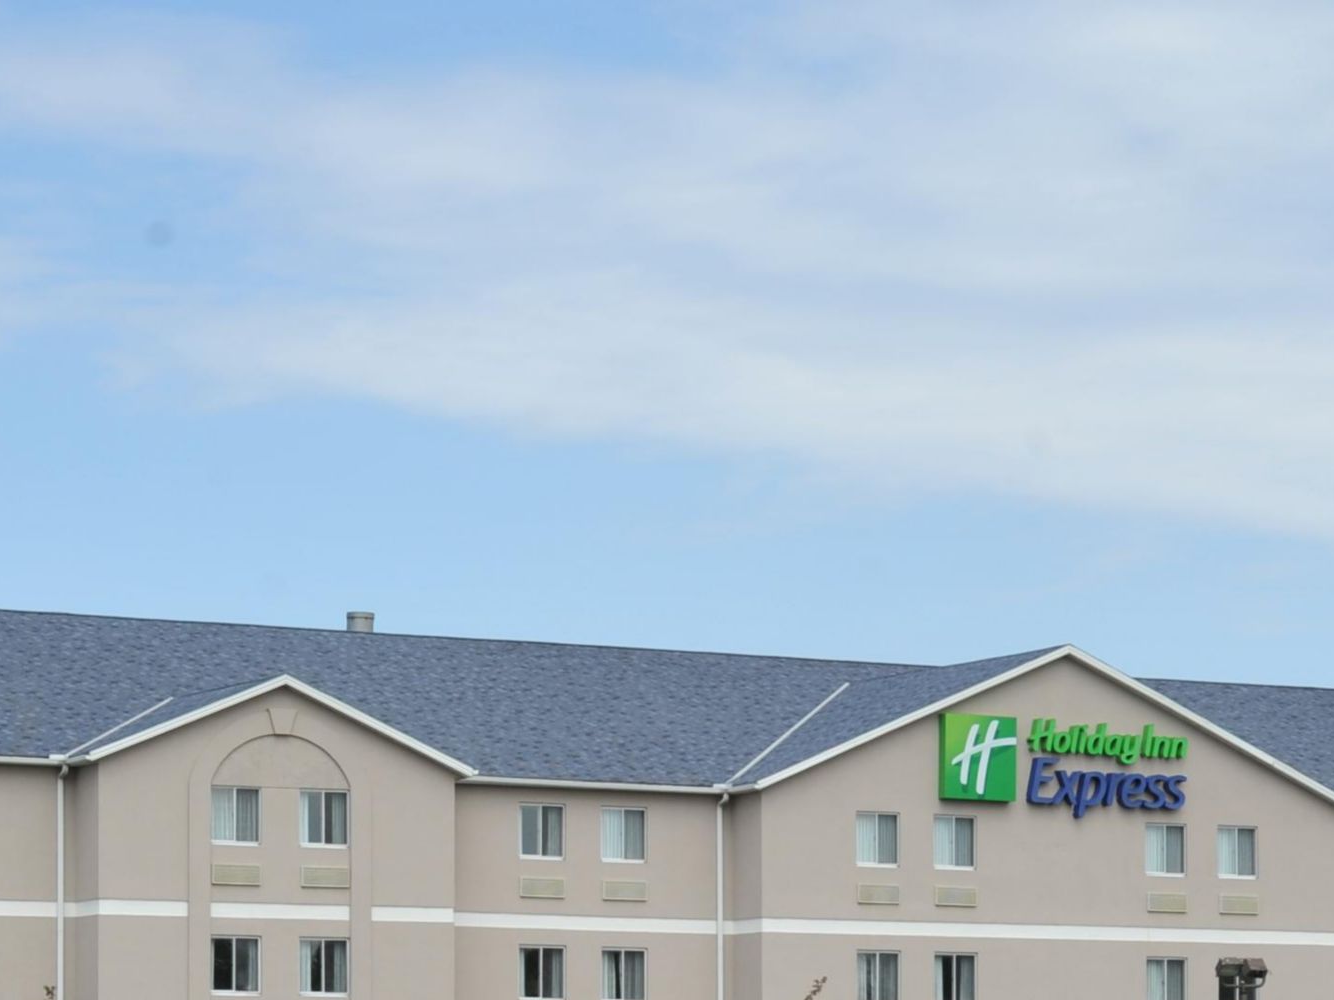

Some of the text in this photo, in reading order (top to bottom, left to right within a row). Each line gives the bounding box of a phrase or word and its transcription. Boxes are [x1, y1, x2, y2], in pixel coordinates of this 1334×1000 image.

[1027, 717, 1190, 766] Holiday Inn
[1026, 756, 1187, 819] Express
